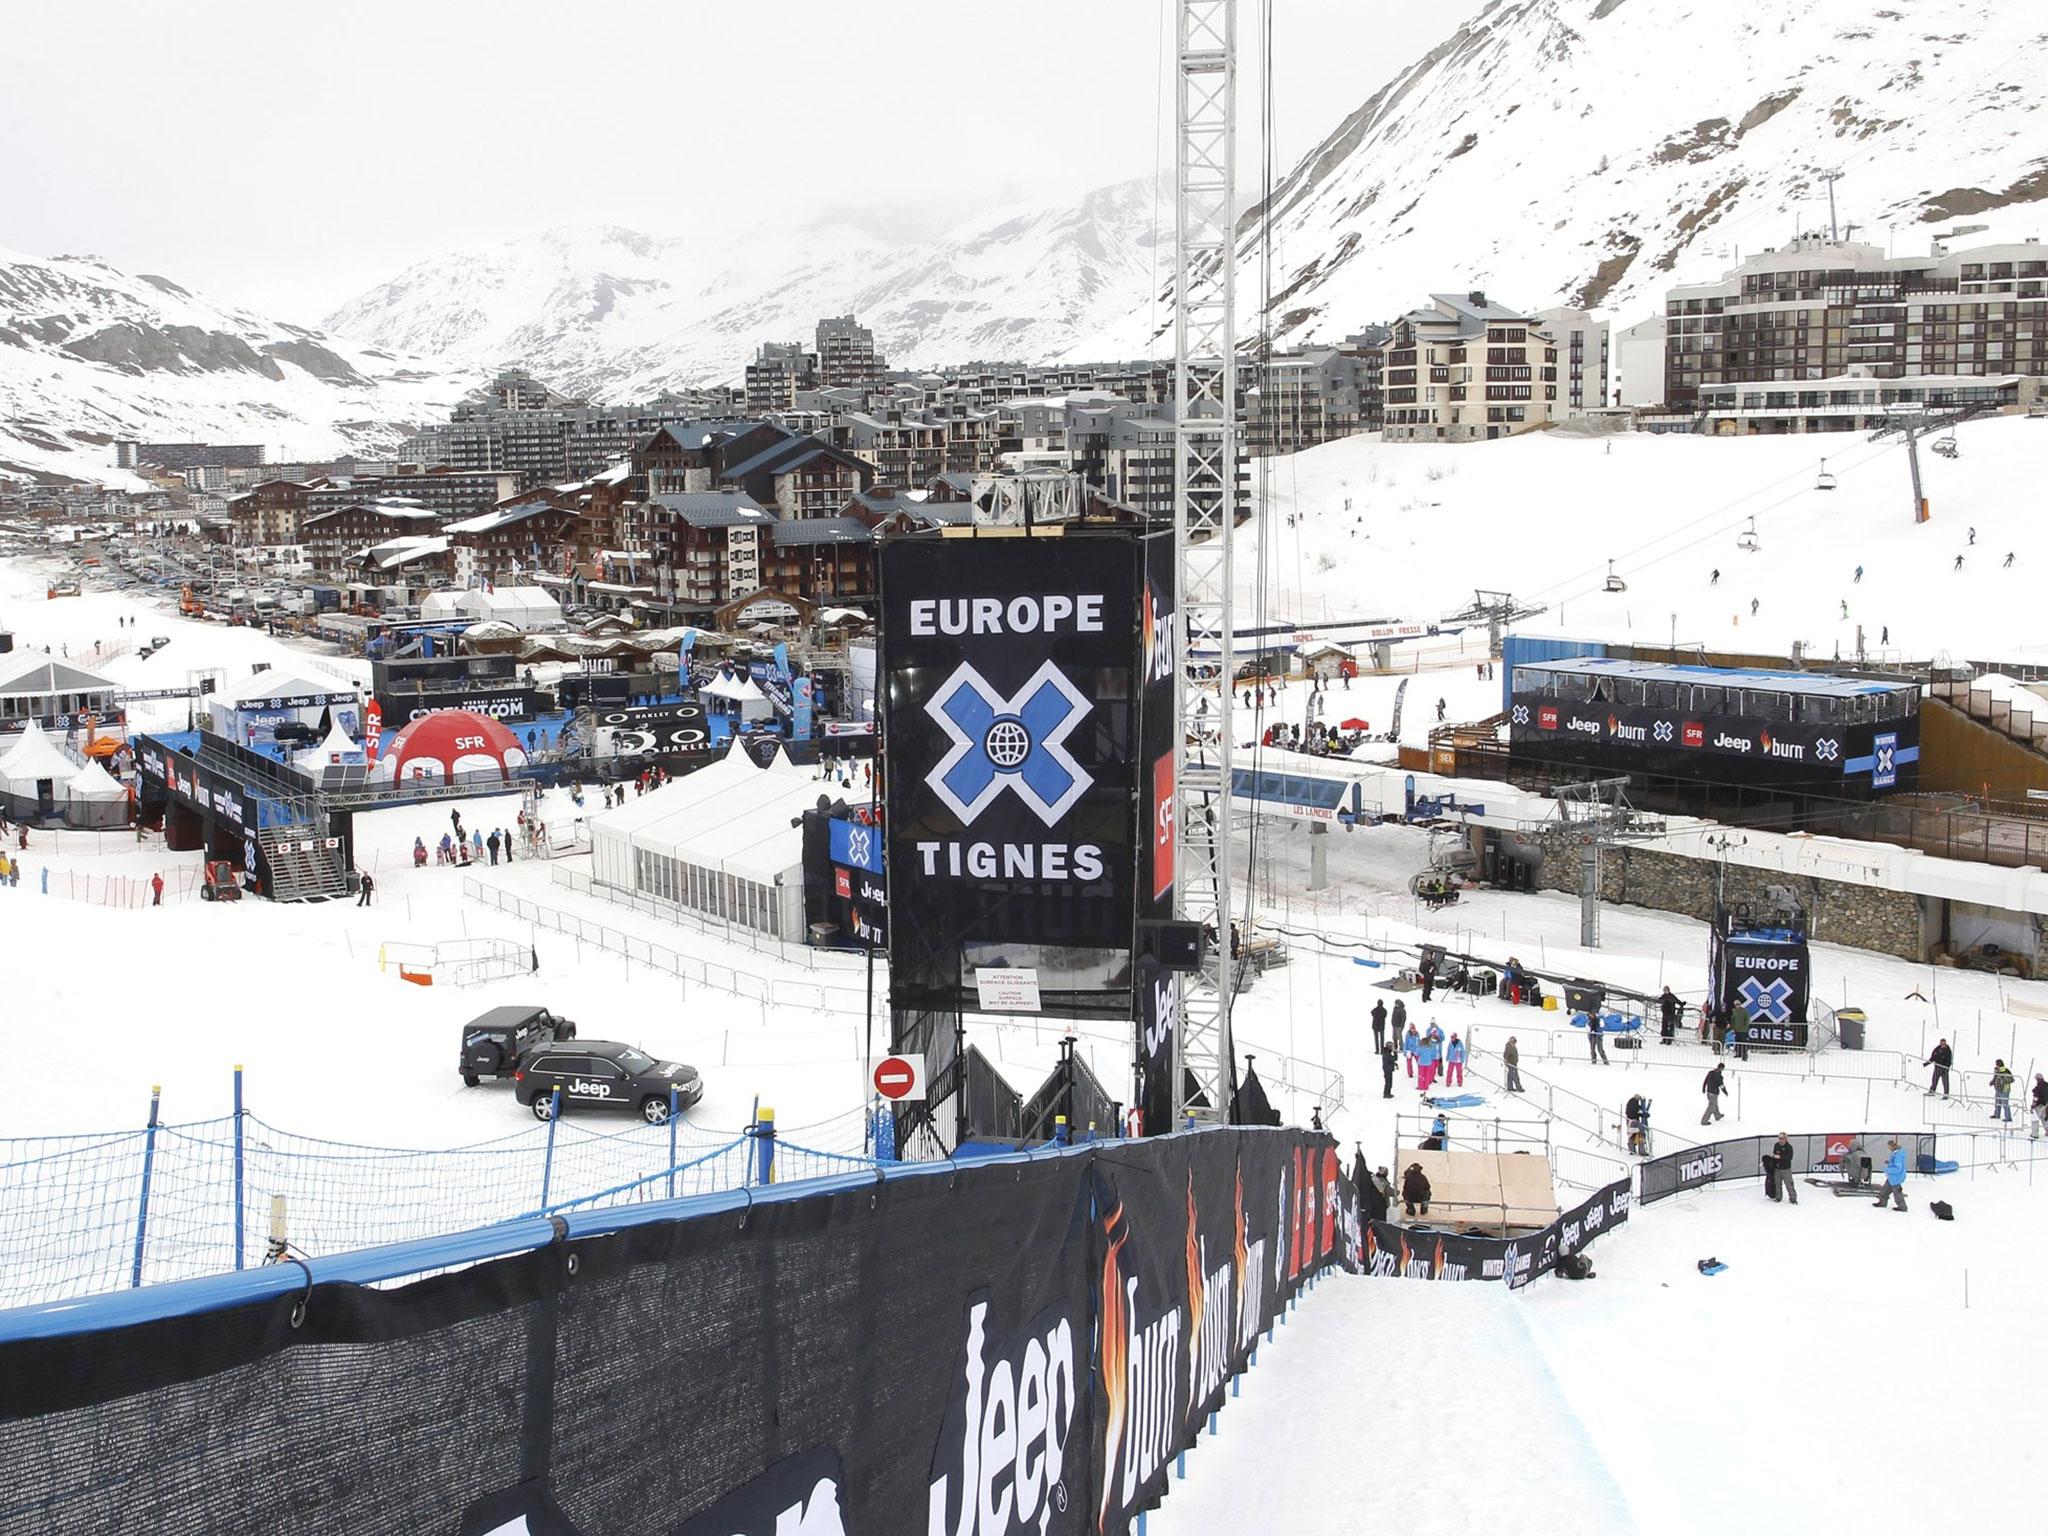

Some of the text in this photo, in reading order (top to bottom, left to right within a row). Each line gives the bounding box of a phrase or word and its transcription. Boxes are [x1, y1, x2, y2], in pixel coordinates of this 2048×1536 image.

[911, 595, 1104, 635] EUROPE
[1152, 597, 1175, 681] bur
[580, 655, 612, 672] burn
[242, 701, 264, 709] Jeep
[288, 697, 310, 706] Jeep
[332, 694, 353, 702] Jeep
[251, 714, 285, 726] Jeep
[409, 702, 524, 721] COPT.COM
[1542, 712, 1557, 722] SFR
[366, 713, 382, 749] SFR
[1567, 716, 1600, 735] Jeep
[1618, 720, 1647, 741] burn
[1686, 729, 1703, 739] SFR
[455, 735, 485, 750] SFR
[663, 742, 711, 752] OAKLEY
[1714, 733, 1751, 752] Jeep
[1772, 738, 1804, 760] burn
[1160, 796, 1174, 845] SF
[917, 842, 1104, 880] TIGNES
[1735, 956, 1799, 971] EUROPE
[1146, 978, 1174, 1058] Jee
[1748, 1027, 1794, 1041] GNES
[568, 1078, 611, 1098] Jeep
[1680, 1154, 1723, 1183] TIGNES
[1610, 1191, 1631, 1216] Jeep
[1584, 1203, 1604, 1231] Jeep
[1561, 1221, 1580, 1248] Jeep
[1482, 1259, 1504, 1276] WINTER
[1198, 1234, 1231, 1408] burn
[1123, 1276, 1181, 1509] burn
[928, 1302, 1075, 1536] Jeep
